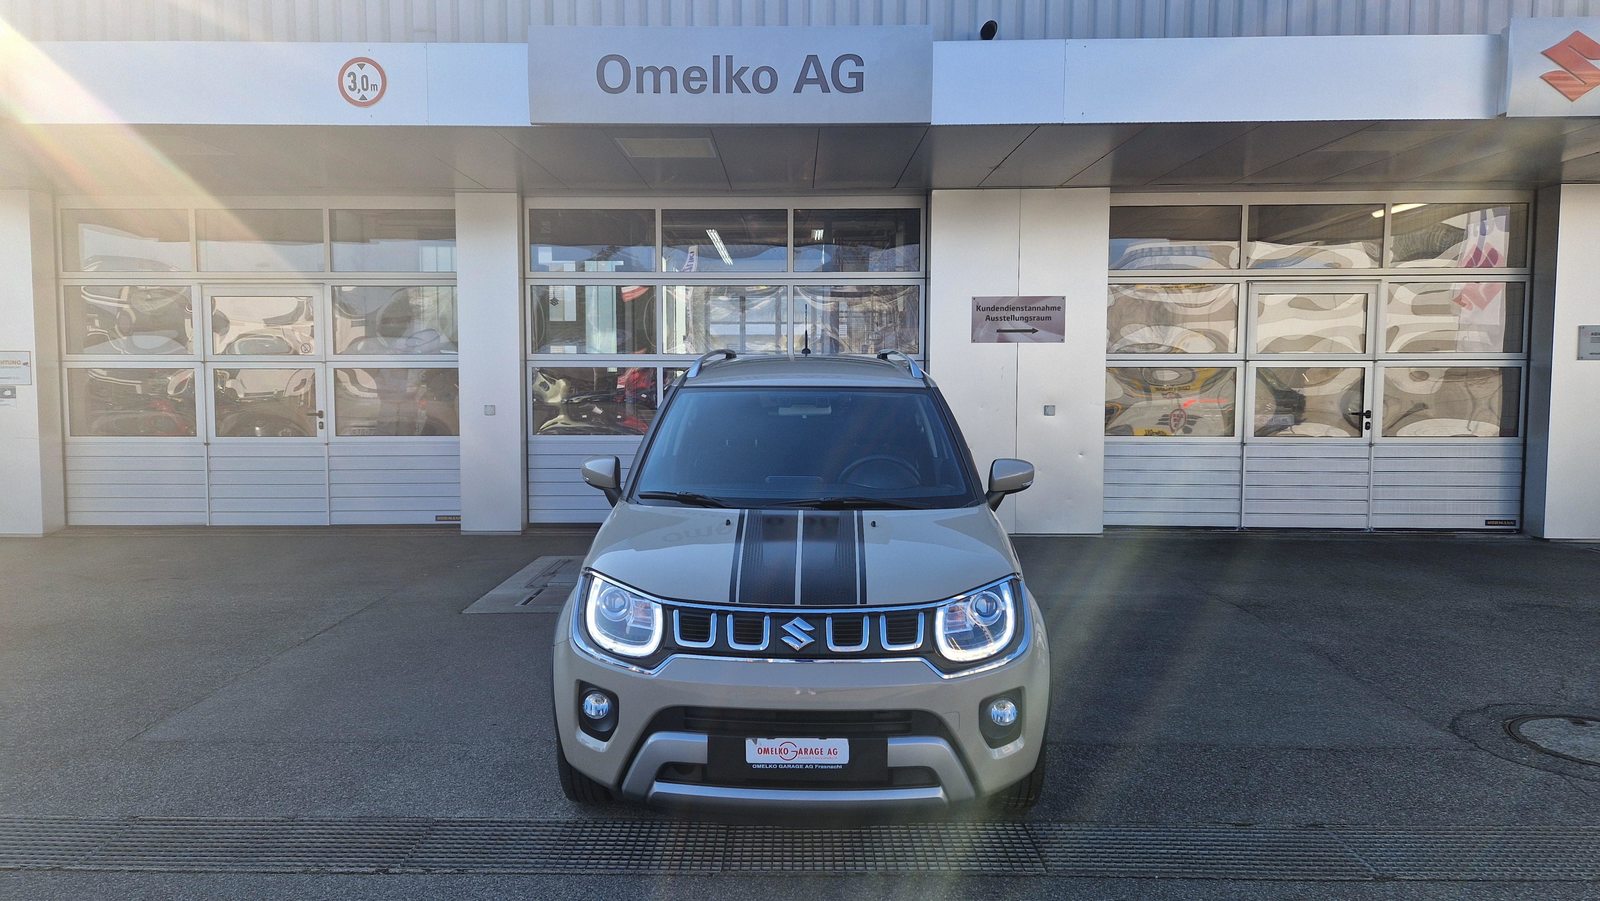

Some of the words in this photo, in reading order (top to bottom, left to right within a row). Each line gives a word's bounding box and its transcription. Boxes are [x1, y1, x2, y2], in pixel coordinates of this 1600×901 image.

[596, 54, 779, 95] Omelko
[792, 53, 865, 94] AG
[984, 314, 1052, 323] Ausstellungsraum
[757, 747, 789, 756] OMELKO
[827, 748, 838, 756] AG
